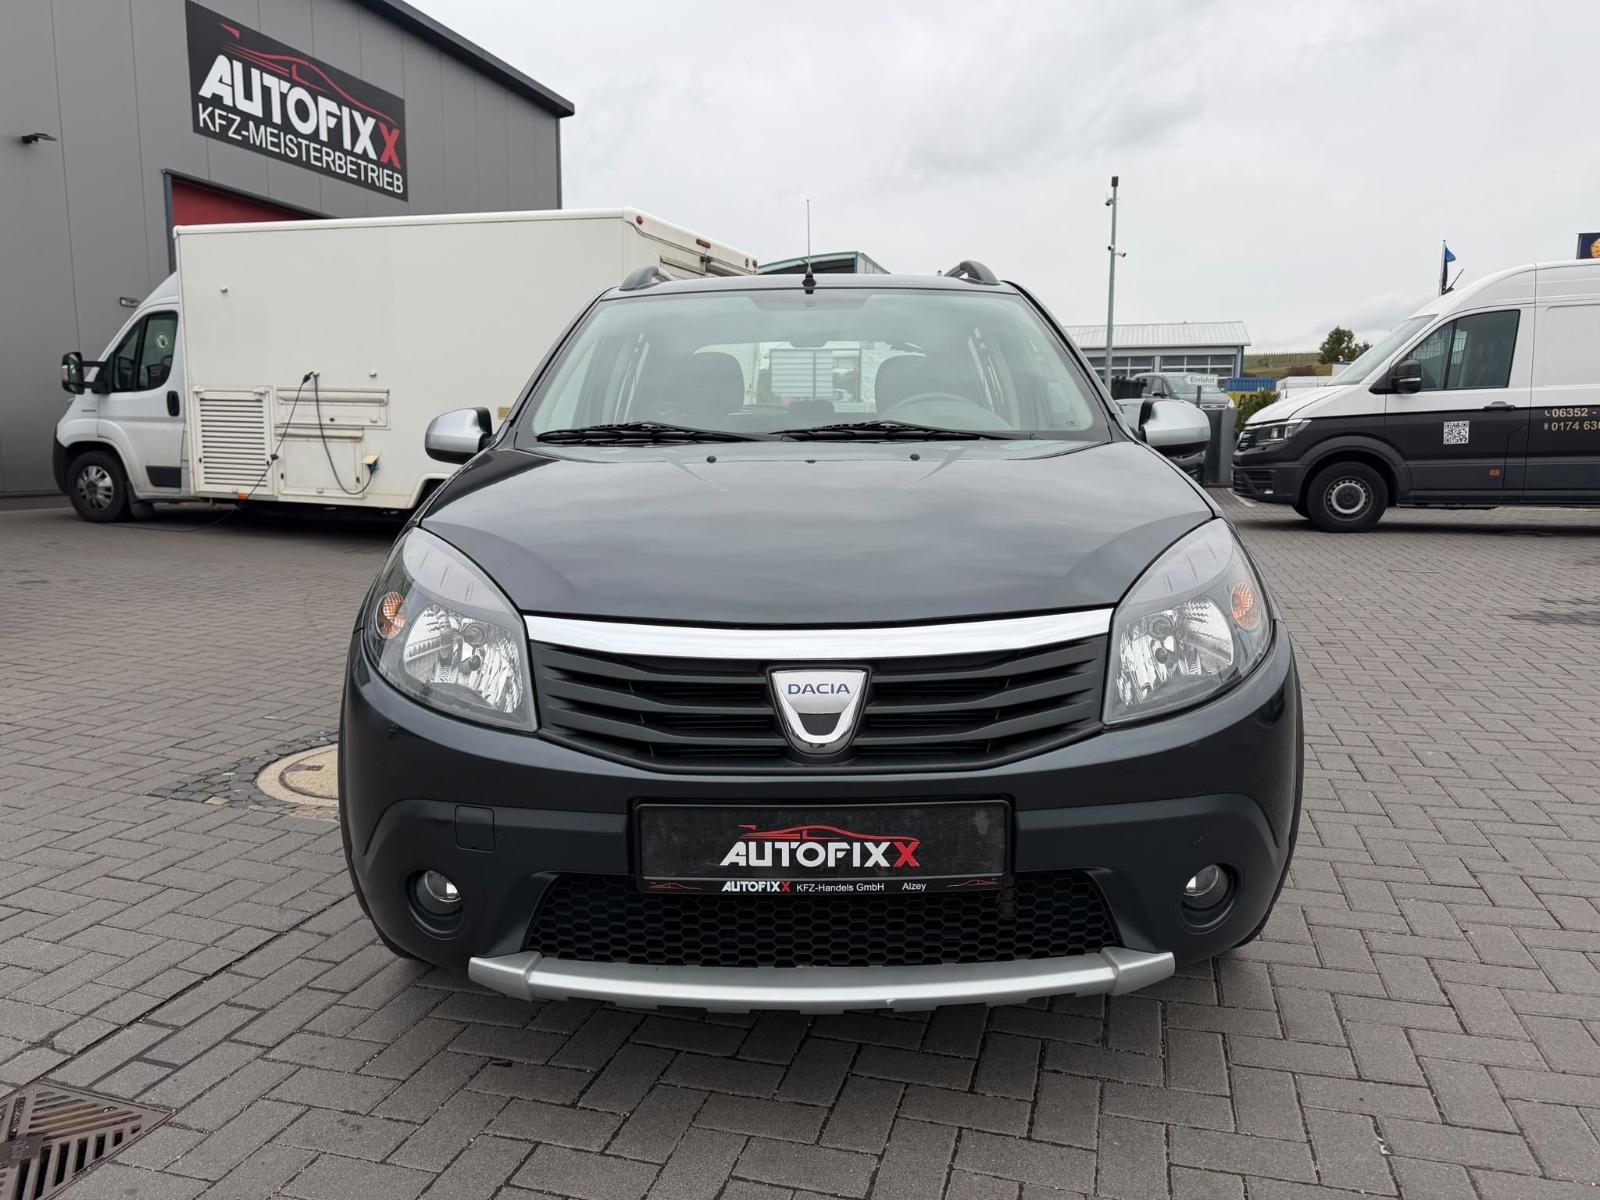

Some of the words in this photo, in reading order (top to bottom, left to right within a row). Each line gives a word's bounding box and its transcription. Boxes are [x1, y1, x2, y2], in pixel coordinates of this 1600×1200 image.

[198, 54, 401, 170] AUTOFIXX
[198, 102, 404, 194] KFZ-MEISTERBETRIEB
[1552, 408, 1588, 418] 06352
[1551, 421, 1580, 431] 0174
[787, 683, 851, 695] DACIA
[720, 841, 920, 868] AUTOFIXX
[721, 880, 791, 893] AUTOFIXX
[796, 883, 854, 893] KFZ-Handels
[856, 882, 885, 892] GmbH
[902, 881, 927, 892] Alzey
